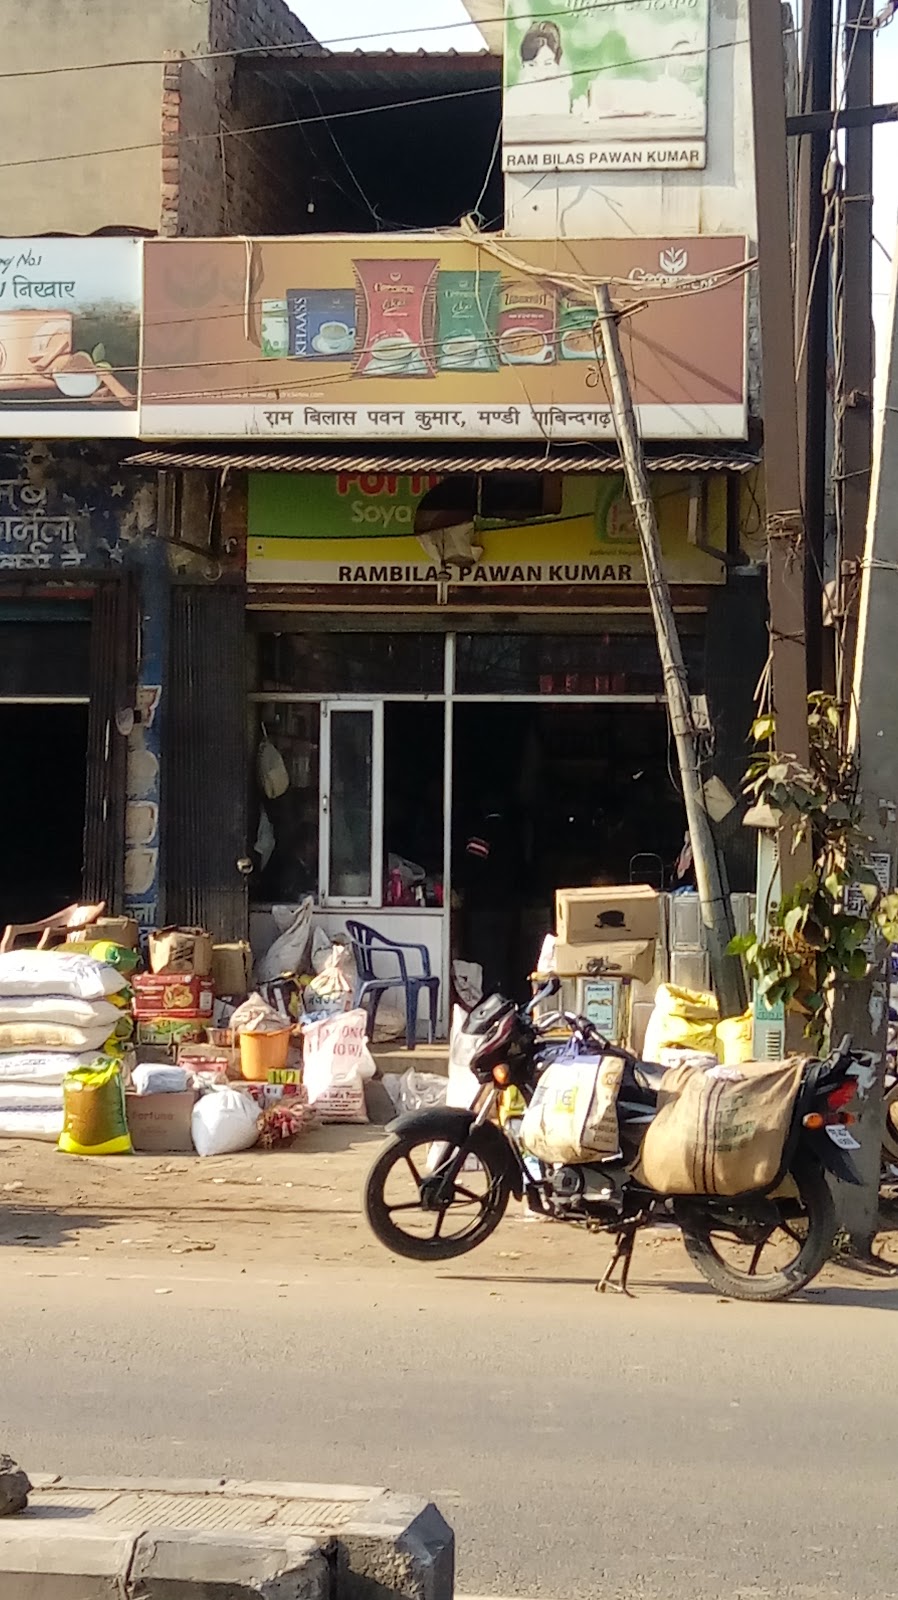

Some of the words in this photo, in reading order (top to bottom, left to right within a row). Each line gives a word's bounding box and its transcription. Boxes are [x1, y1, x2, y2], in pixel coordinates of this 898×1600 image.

[506, 154, 539, 167] RAM
[542, 152, 585, 166] BILAS
[589, 151, 643, 164] PAWAN
[646, 149, 700, 163] KUMAR
[12, 274, 76, 299] निखार
[263, 411, 294, 428] राम
[303, 406, 357, 426] बिलास
[367, 410, 404, 426] पवन
[415, 410, 466, 430] कुमार,
[478, 406, 521, 426] मण्डी
[351, 500, 412, 527] Soya
[338, 565, 453, 582] RAMBILAS
[459, 564, 541, 582] PAWAN
[549, 564, 632, 581] KUMAR
